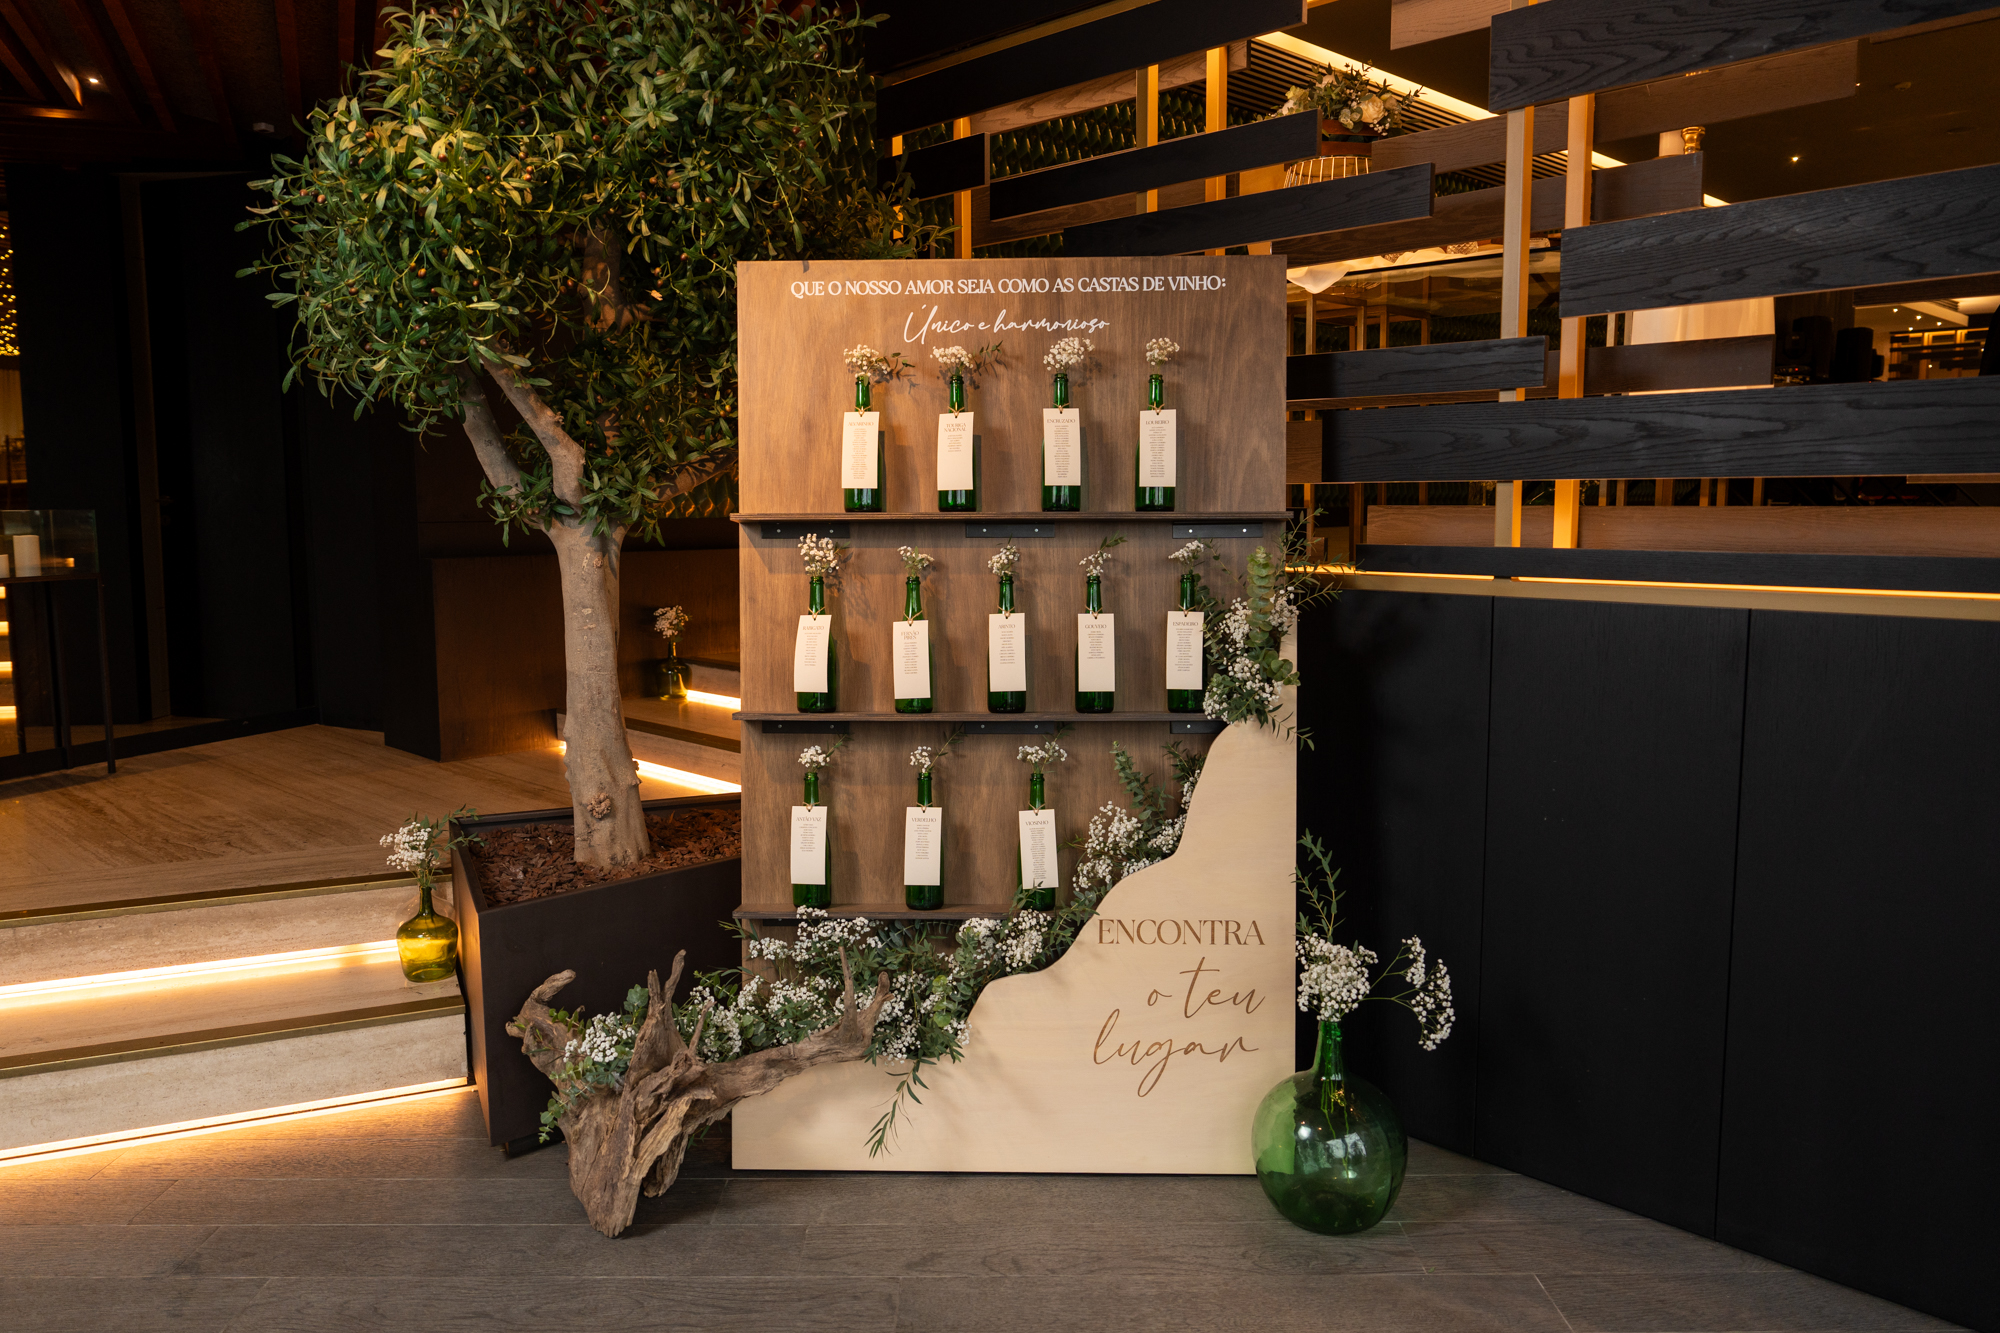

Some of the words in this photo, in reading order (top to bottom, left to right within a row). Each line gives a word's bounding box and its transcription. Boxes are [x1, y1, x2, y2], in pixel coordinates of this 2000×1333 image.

[791, 281, 824, 299] QUE
[828, 281, 842, 295] O
[845, 280, 901, 295] NOSSO
[905, 279, 955, 295] AMOR
[957, 279, 995, 294] SEJA
[998, 278, 1049, 294] COMO
[1052, 277, 1074, 293] AS
[1078, 276, 1139, 292] CASTAS
[1142, 276, 1165, 291] DE
[1168, 275, 1226, 291] VINHO:
[903, 304, 974, 344] Único
[978, 320, 991, 330] e
[993, 309, 1110, 333] harmonioso
[1097, 919, 1266, 945] ENCONTRA
[1147, 989, 1172, 1006] o
[1179, 956, 1266, 1019] teu
[1093, 1008, 1259, 1097] lugar
